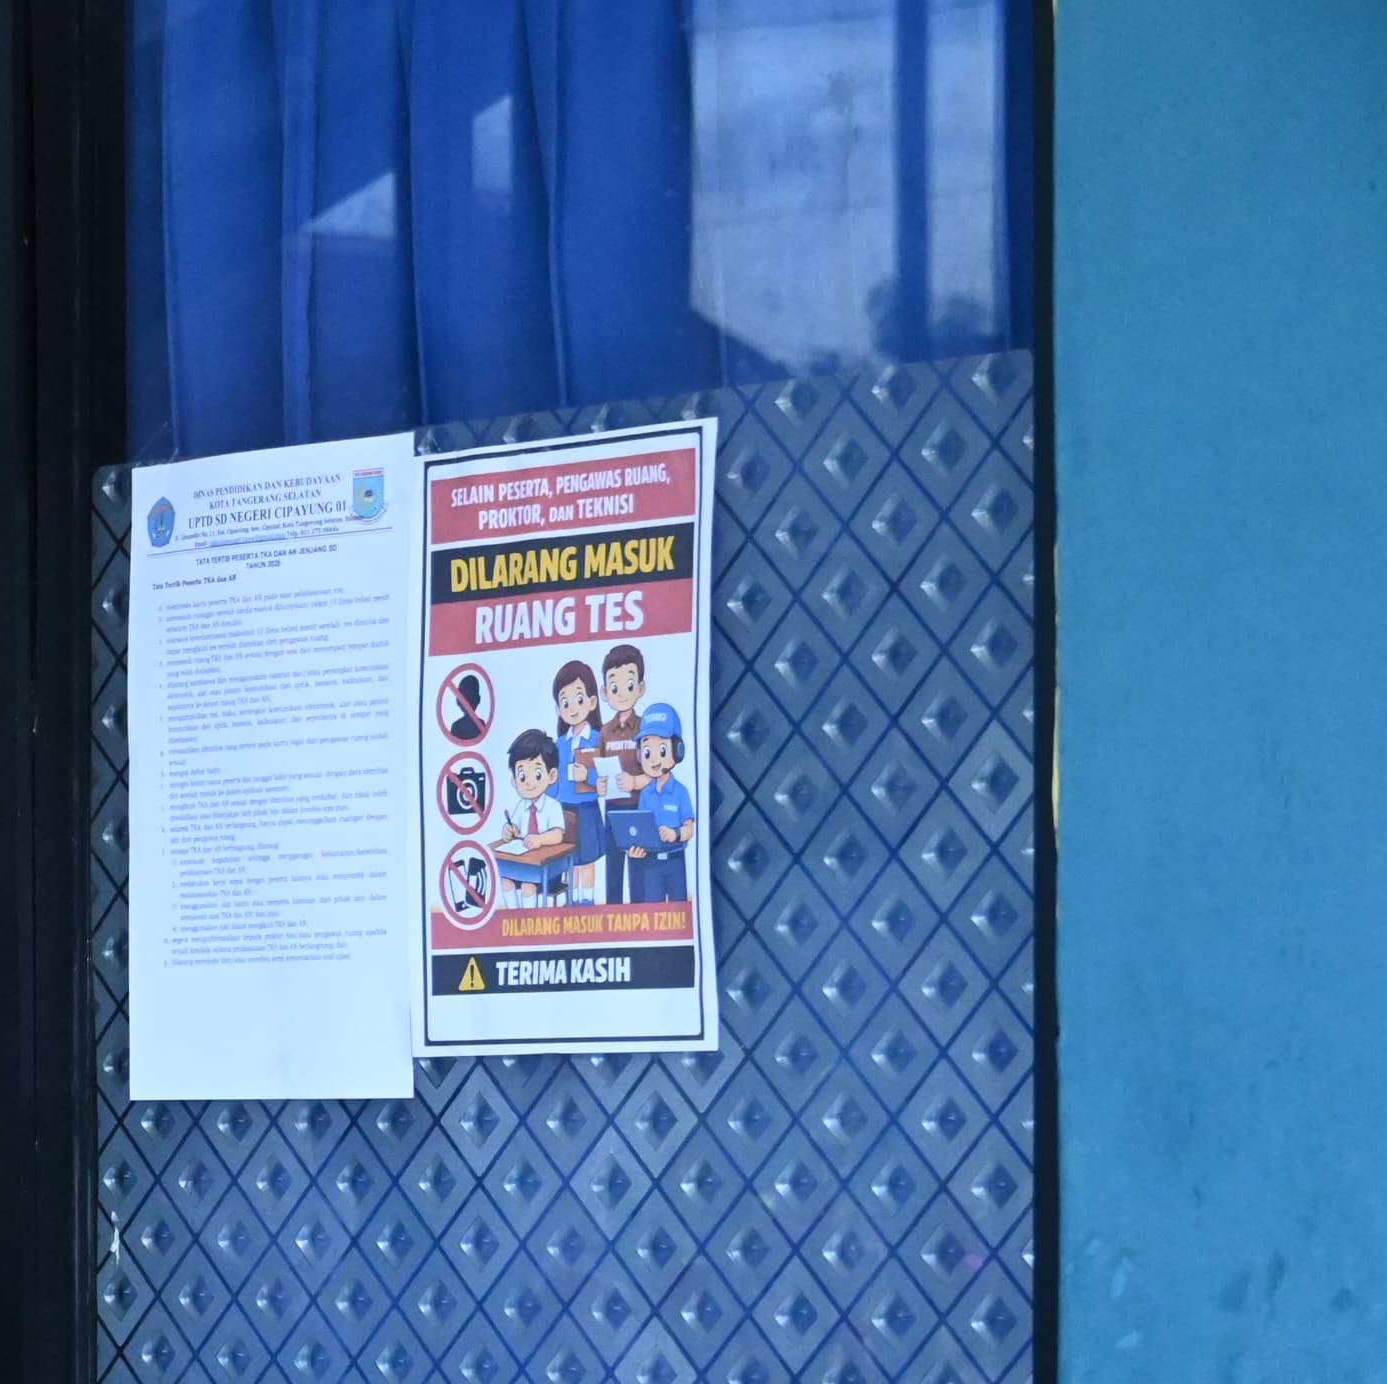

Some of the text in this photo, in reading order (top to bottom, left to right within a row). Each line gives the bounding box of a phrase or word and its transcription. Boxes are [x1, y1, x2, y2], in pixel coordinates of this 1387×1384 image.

[216, 481, 263, 496] PENDIDIKAN
[284, 474, 341, 489] KEBUDAYAAN
[232, 493, 283, 508] TANGERANG
[284, 489, 322, 501] SELATAN
[451, 463, 670, 508] SELAIN PESERTA, PENGAWAS RUANG,
[188, 515, 213, 530] UPTD
[215, 513, 228, 526] SD
[230, 507, 271, 524] NEGERI
[274, 501, 333, 521] CIPAYUNG
[336, 500, 347, 512] 01
[478, 493, 634, 530] PROKTOR, DAN TEKNISI
[450, 536, 675, 593] DILARANG MASUK
[475, 591, 645, 645] RUANG TES
[502, 911, 686, 937] DILARANG MASUK TANPA IZIN!
[496, 956, 631, 986] TERIMA KASIH
